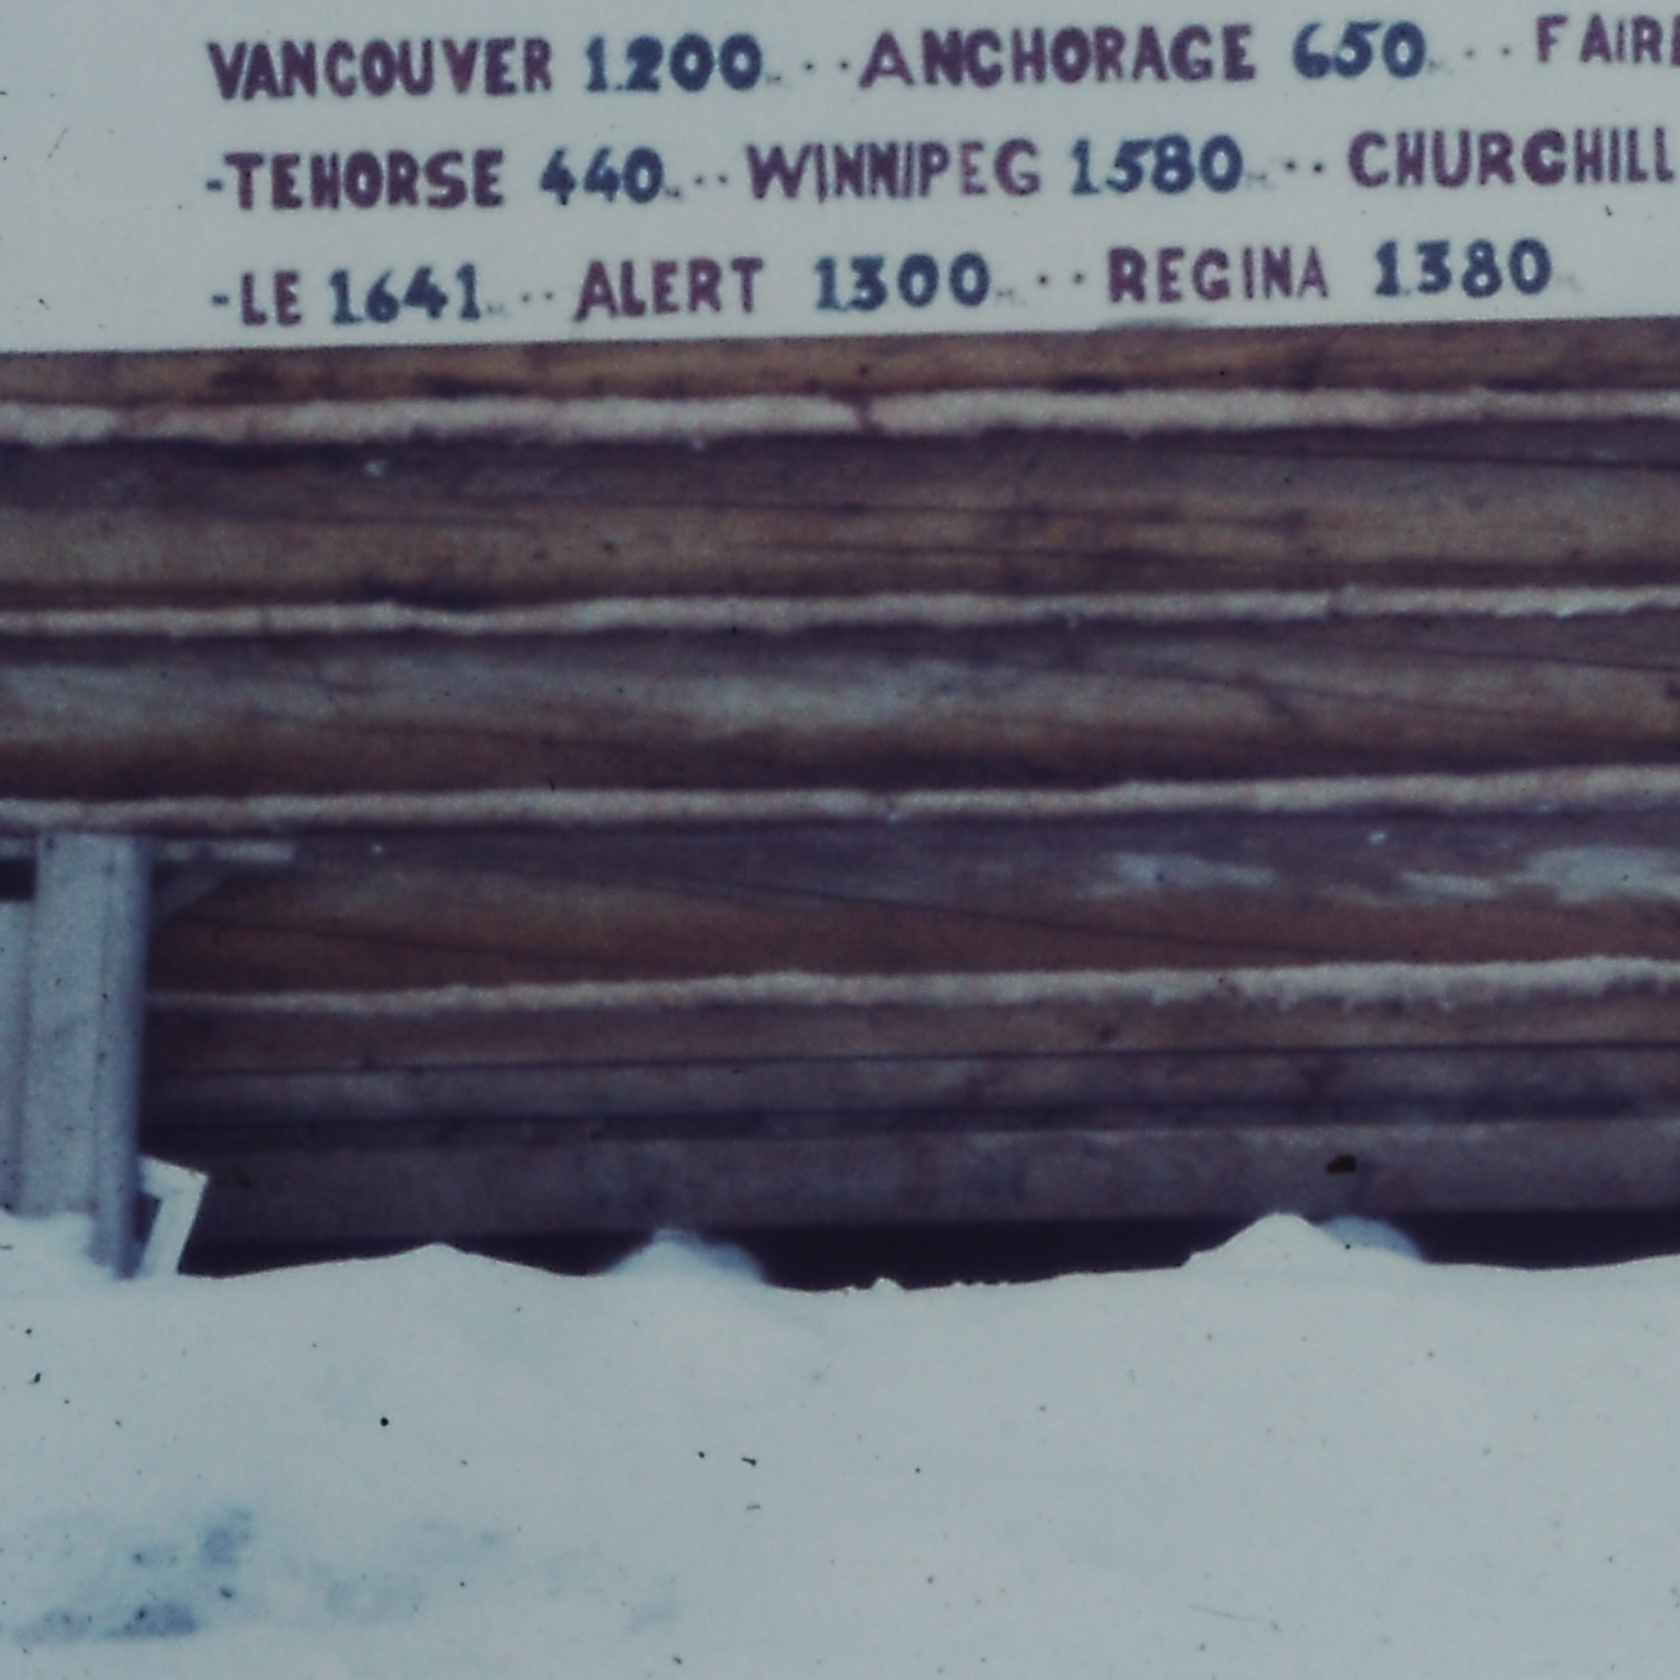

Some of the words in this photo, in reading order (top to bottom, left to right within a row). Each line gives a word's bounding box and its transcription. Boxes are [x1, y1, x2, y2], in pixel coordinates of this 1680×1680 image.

[204, 34, 554, 103] VANCOUVER
[857, 22, 1258, 91] ANCHORAGE
[1290, 19, 1429, 82] 650
[204, 146, 506, 212] -TEHORSE
[537, 144, 668, 208] 440
[743, 136, 1043, 205] WINNIPEG
[1345, 124, 1676, 191] CHURCHILL
[571, 255, 766, 325] ALERT
[1105, 244, 1330, 306] REGINA
